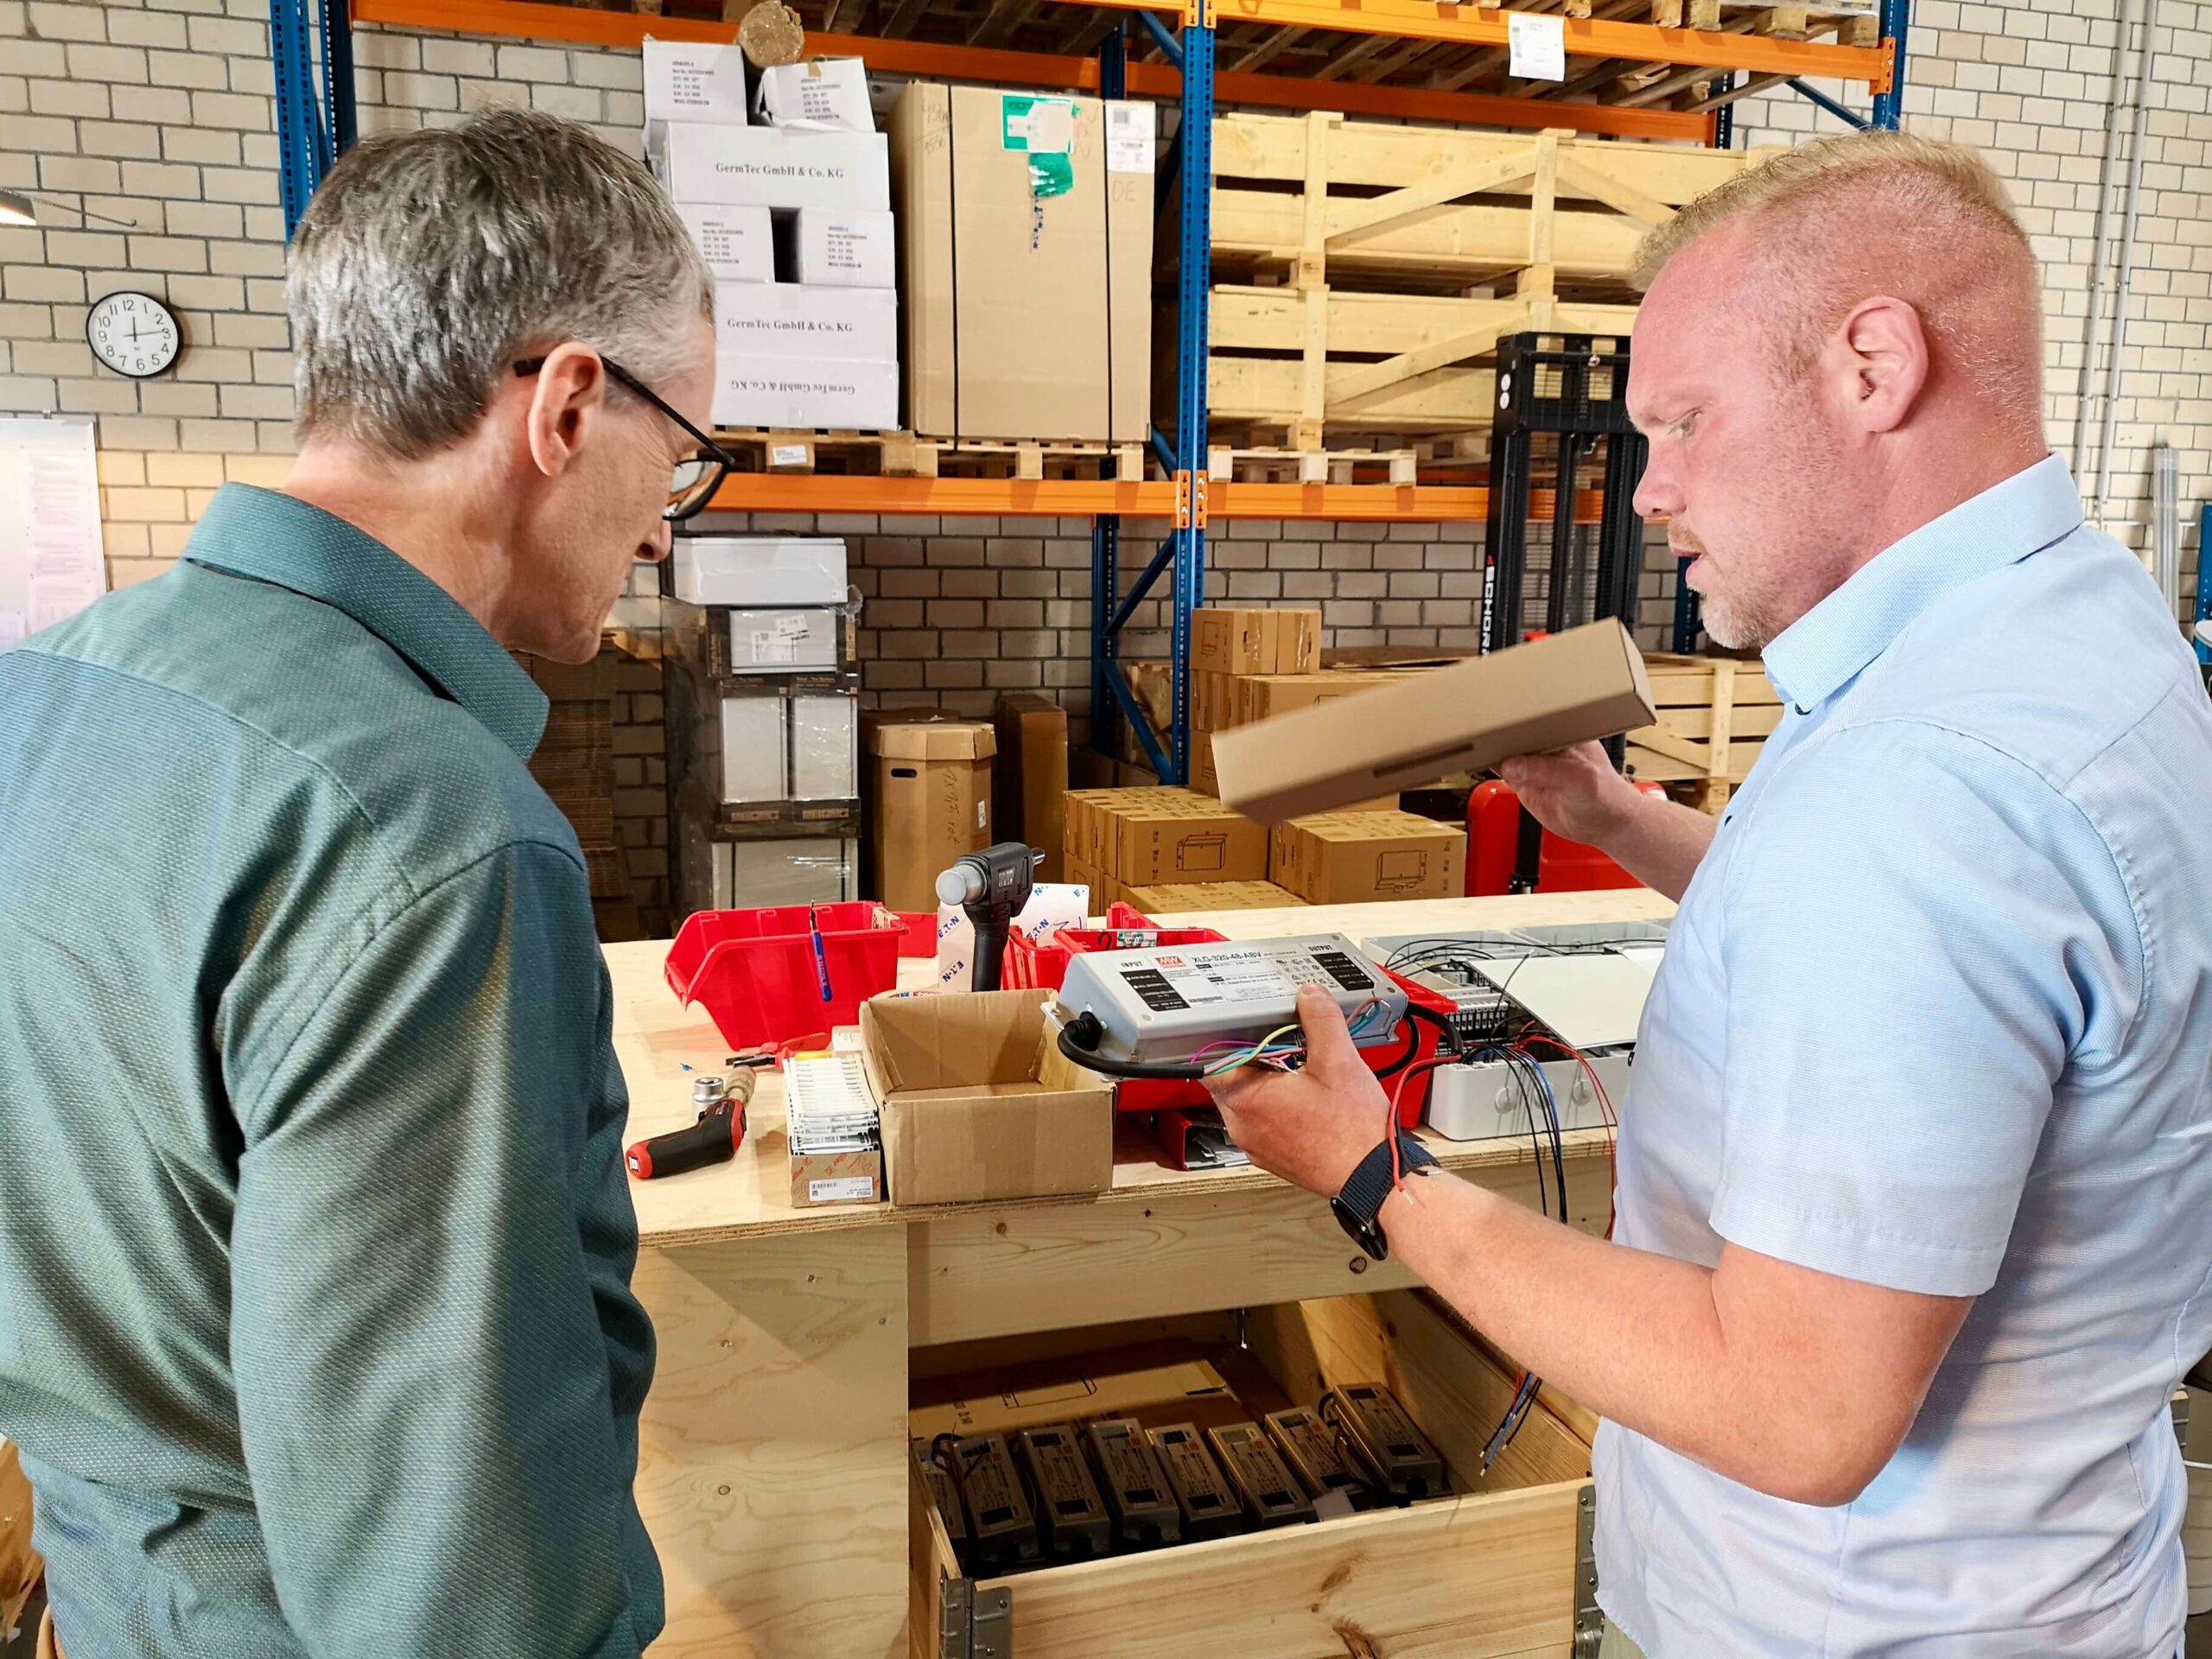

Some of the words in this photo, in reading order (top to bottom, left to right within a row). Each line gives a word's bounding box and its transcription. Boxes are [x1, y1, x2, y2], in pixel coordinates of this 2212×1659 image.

[715, 162, 760, 175] GermTec
[763, 164, 795, 176] GmbH
[798, 168, 806, 177] &
[809, 168, 825, 178] Co.
[827, 168, 844, 179] KG
[109, 303, 118, 316] 11
[123, 299, 136, 312] 12
[98, 315, 111, 328] 10
[155, 313, 164, 325] 2
[727, 318, 771, 329] GermTec
[773, 320, 805, 331] GmbH
[807, 322, 816, 331] &
[818, 322, 835, 332] Co.
[836, 323, 853, 333] KG
[98, 330, 108, 343] 9
[105, 345, 115, 358] 8
[161, 342, 169, 354] 4
[118, 355, 127, 367] 7
[136, 358, 146, 371] 6
[151, 353, 161, 365] 5
[730, 380, 747, 390] KG
[769, 382, 778, 391] &
[779, 383, 810, 393] GmbH
[813, 384, 855, 395] GermTec
[1482, 566, 1496, 655] SCHOR
